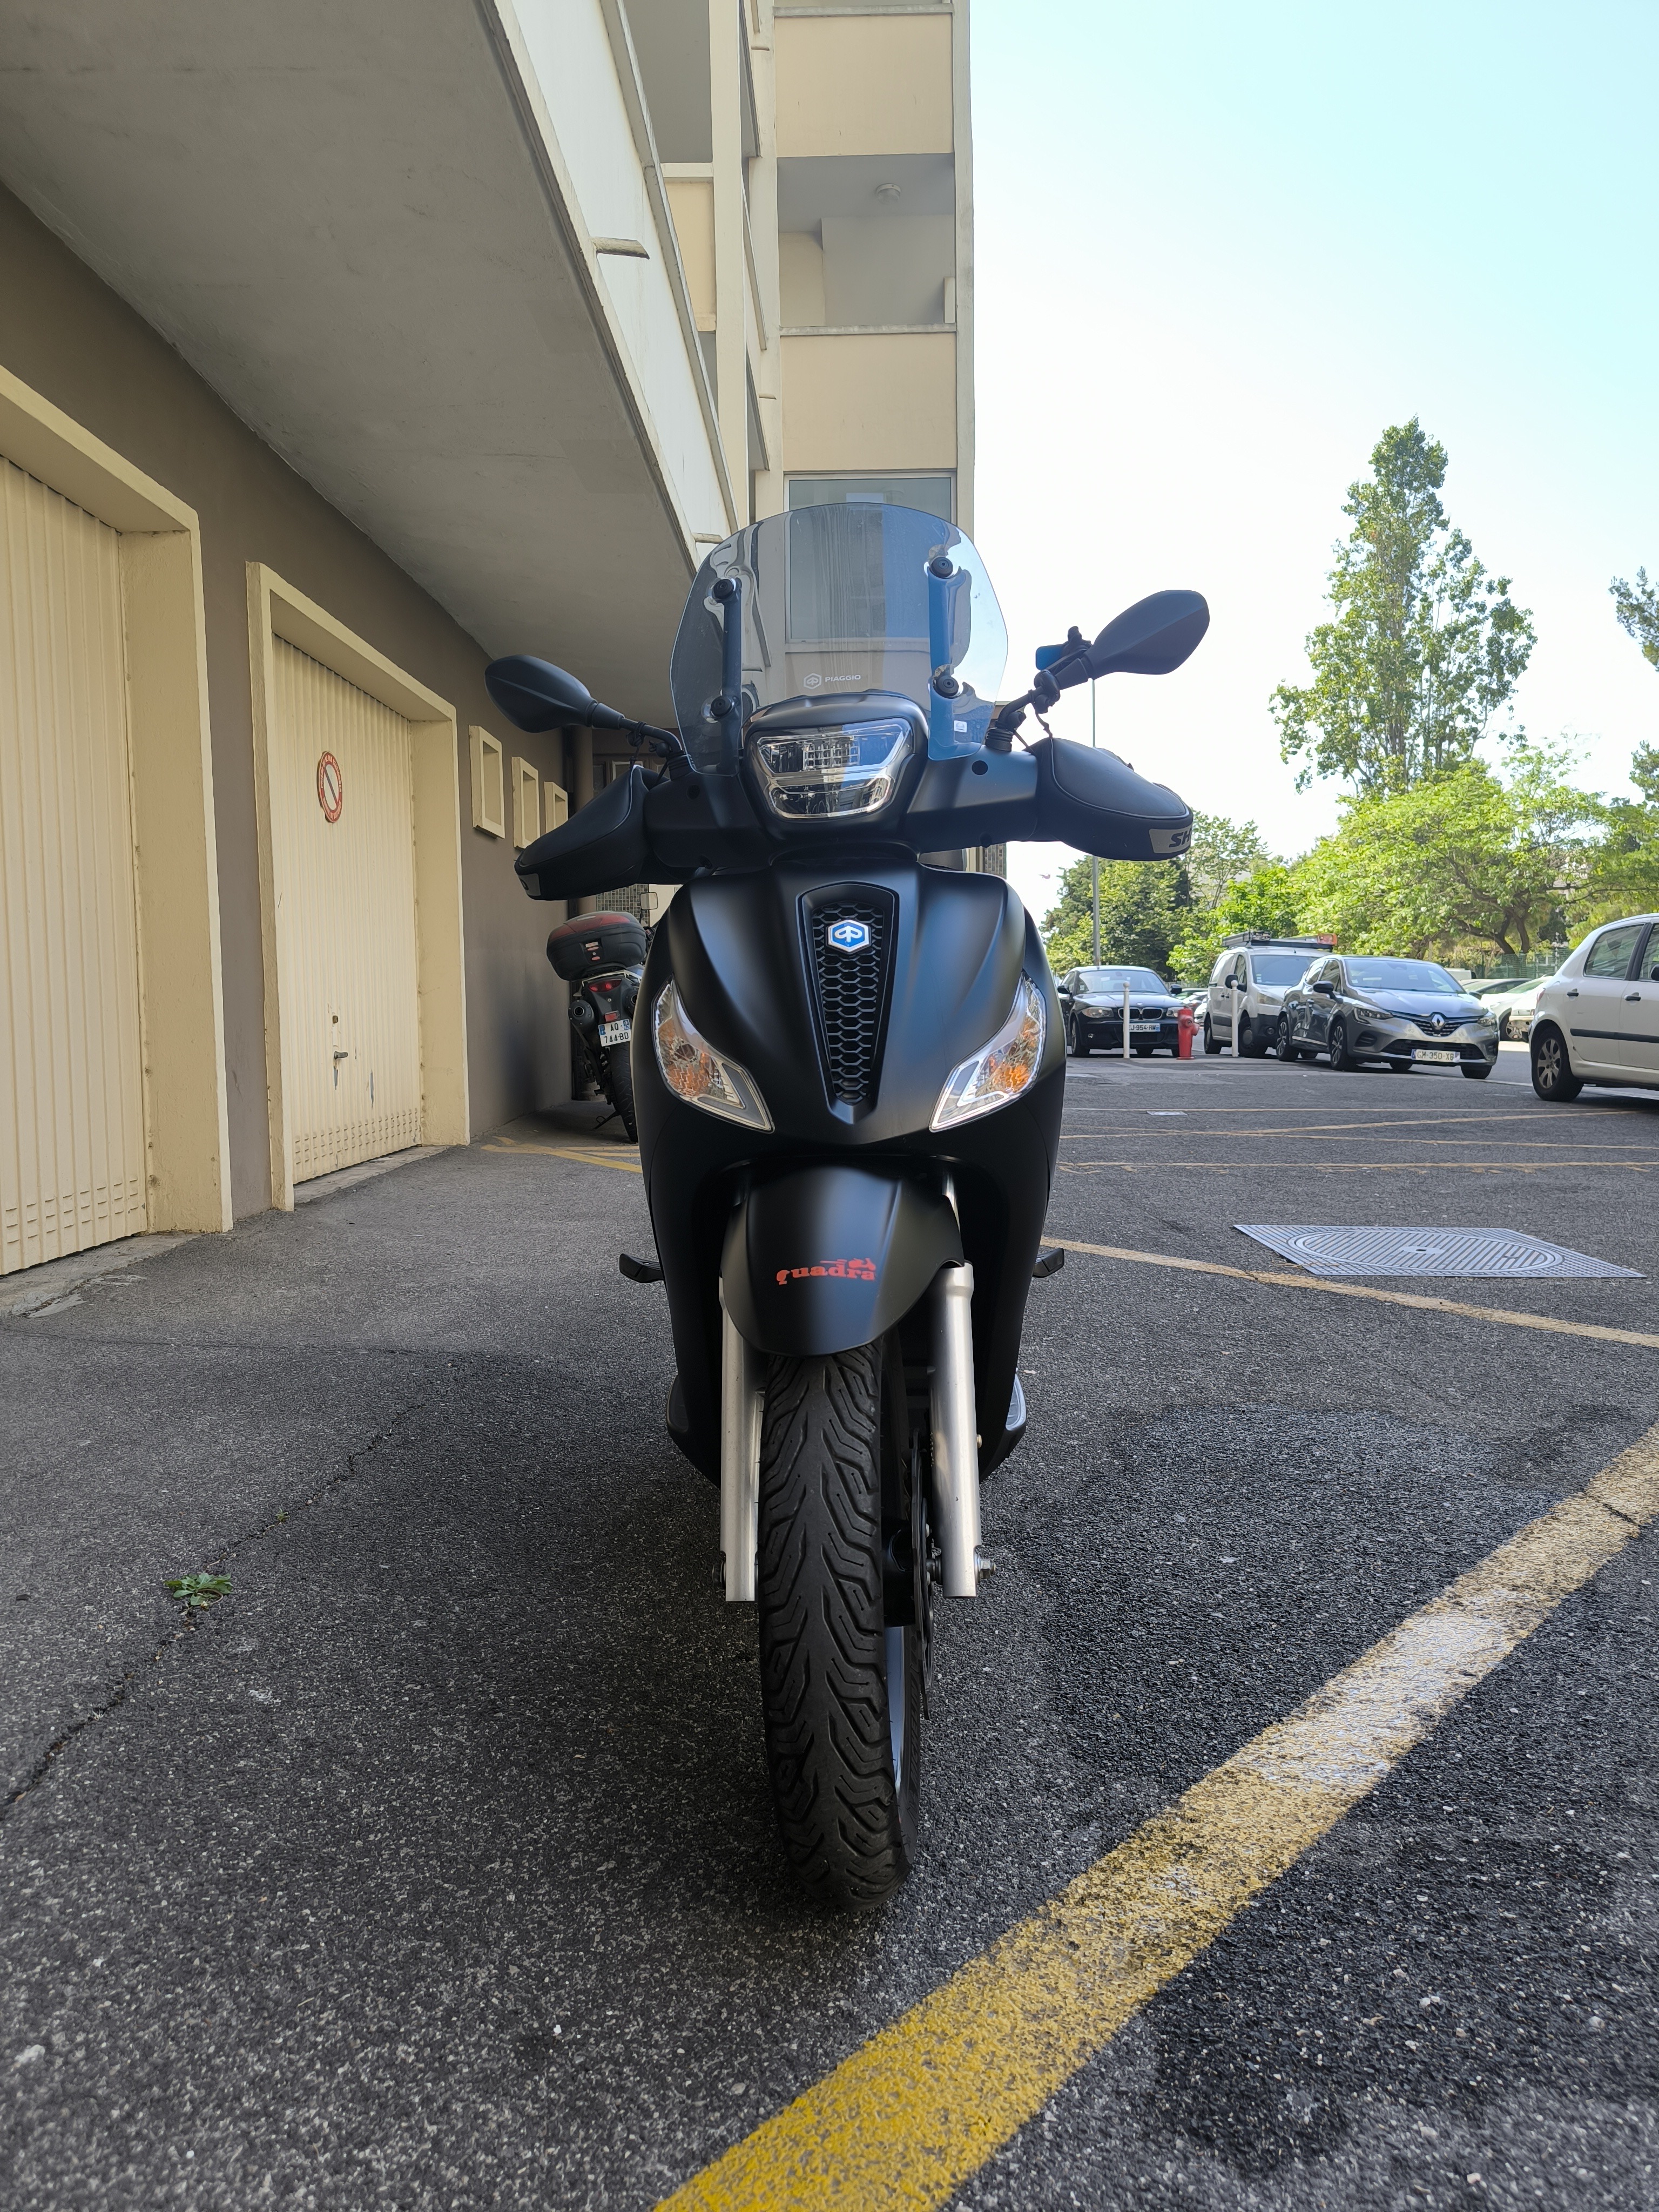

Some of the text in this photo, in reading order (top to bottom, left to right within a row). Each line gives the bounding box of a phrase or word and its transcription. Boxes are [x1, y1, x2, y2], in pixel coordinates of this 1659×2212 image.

[1169, 828, 1191, 848] SH
[603, 1032, 629, 1043] 744-BD
[776, 1259, 876, 1285] quadra
[911, 1682, 919, 1788] MICHELIN
